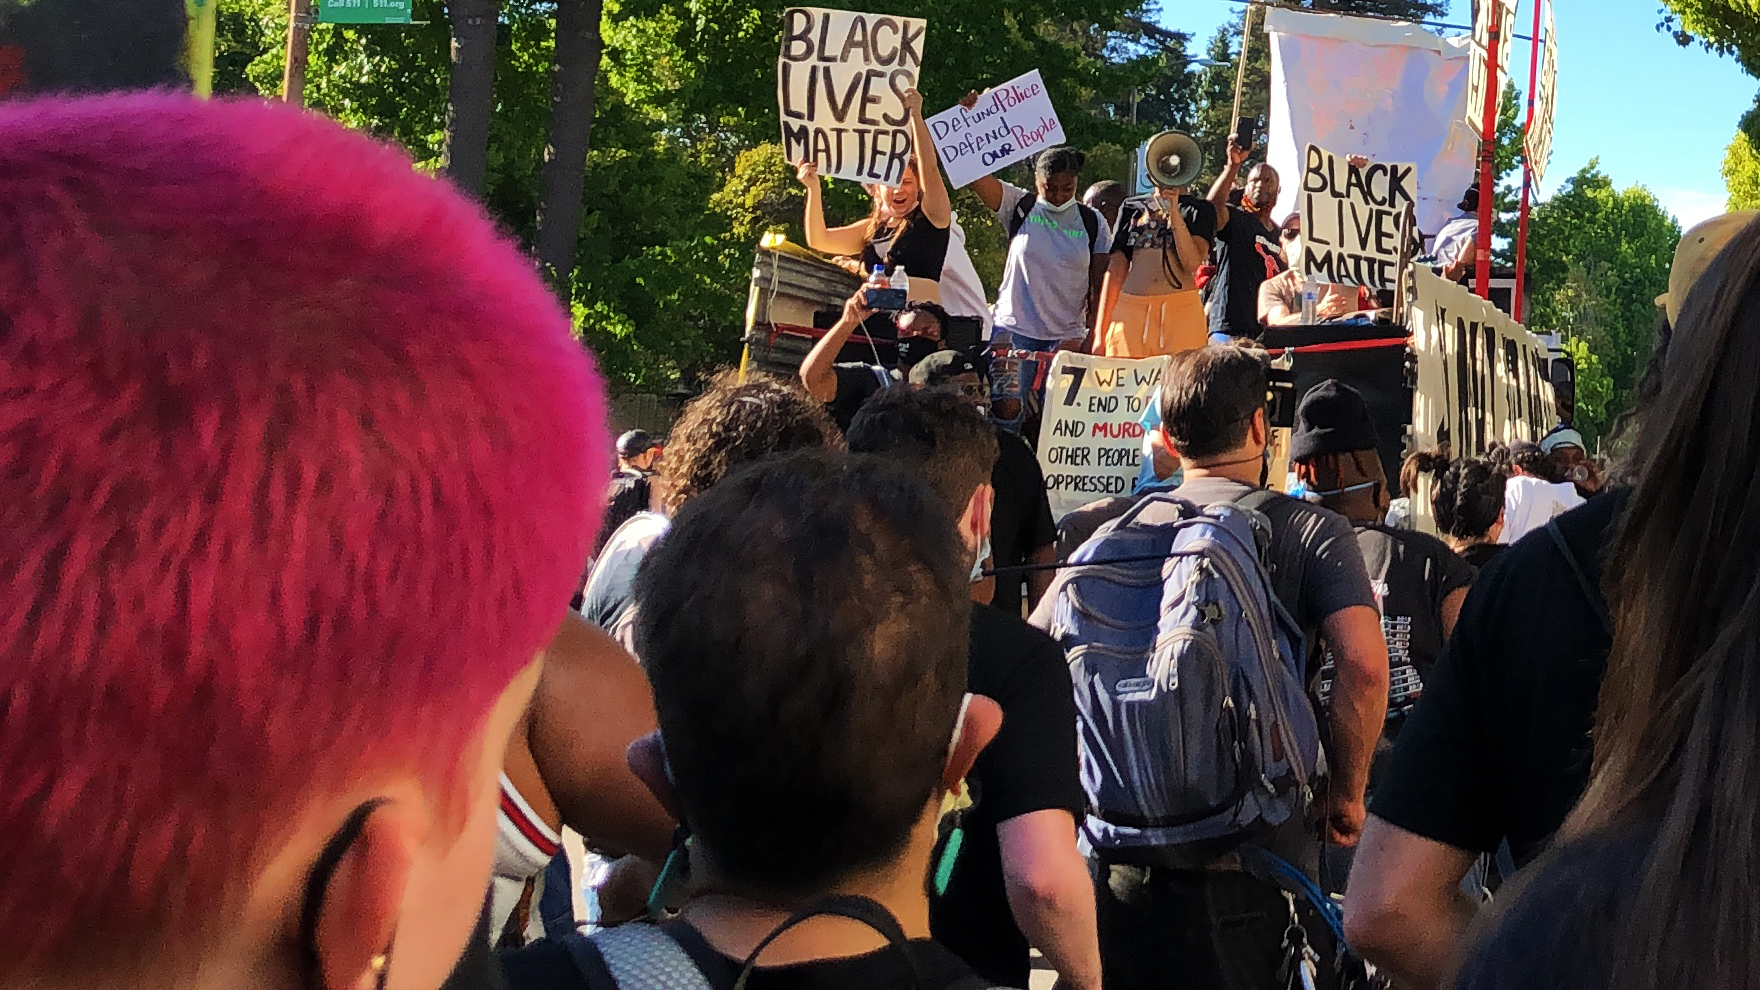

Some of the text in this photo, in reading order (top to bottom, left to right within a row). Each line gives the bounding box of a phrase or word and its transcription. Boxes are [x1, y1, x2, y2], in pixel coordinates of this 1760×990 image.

[328, 0, 405, 9] Call 511 511.org
[781, 8, 926, 68] BLACK
[781, 61, 915, 127] LIVES
[994, 83, 1041, 113] Police
[1010, 116, 1058, 150] People
[783, 120, 912, 183] MATTER
[1303, 144, 1414, 208] BLACK
[1305, 246, 1397, 289] MATTE
[1060, 366, 1162, 408] 7. WE WA
[1088, 396, 1118, 414] END
[1124, 395, 1141, 413] TO
[1052, 420, 1145, 440] AND MURD
[1048, 446, 1140, 468] OTHER PEOPLE
[1046, 474, 1125, 494] OPPRESSED
